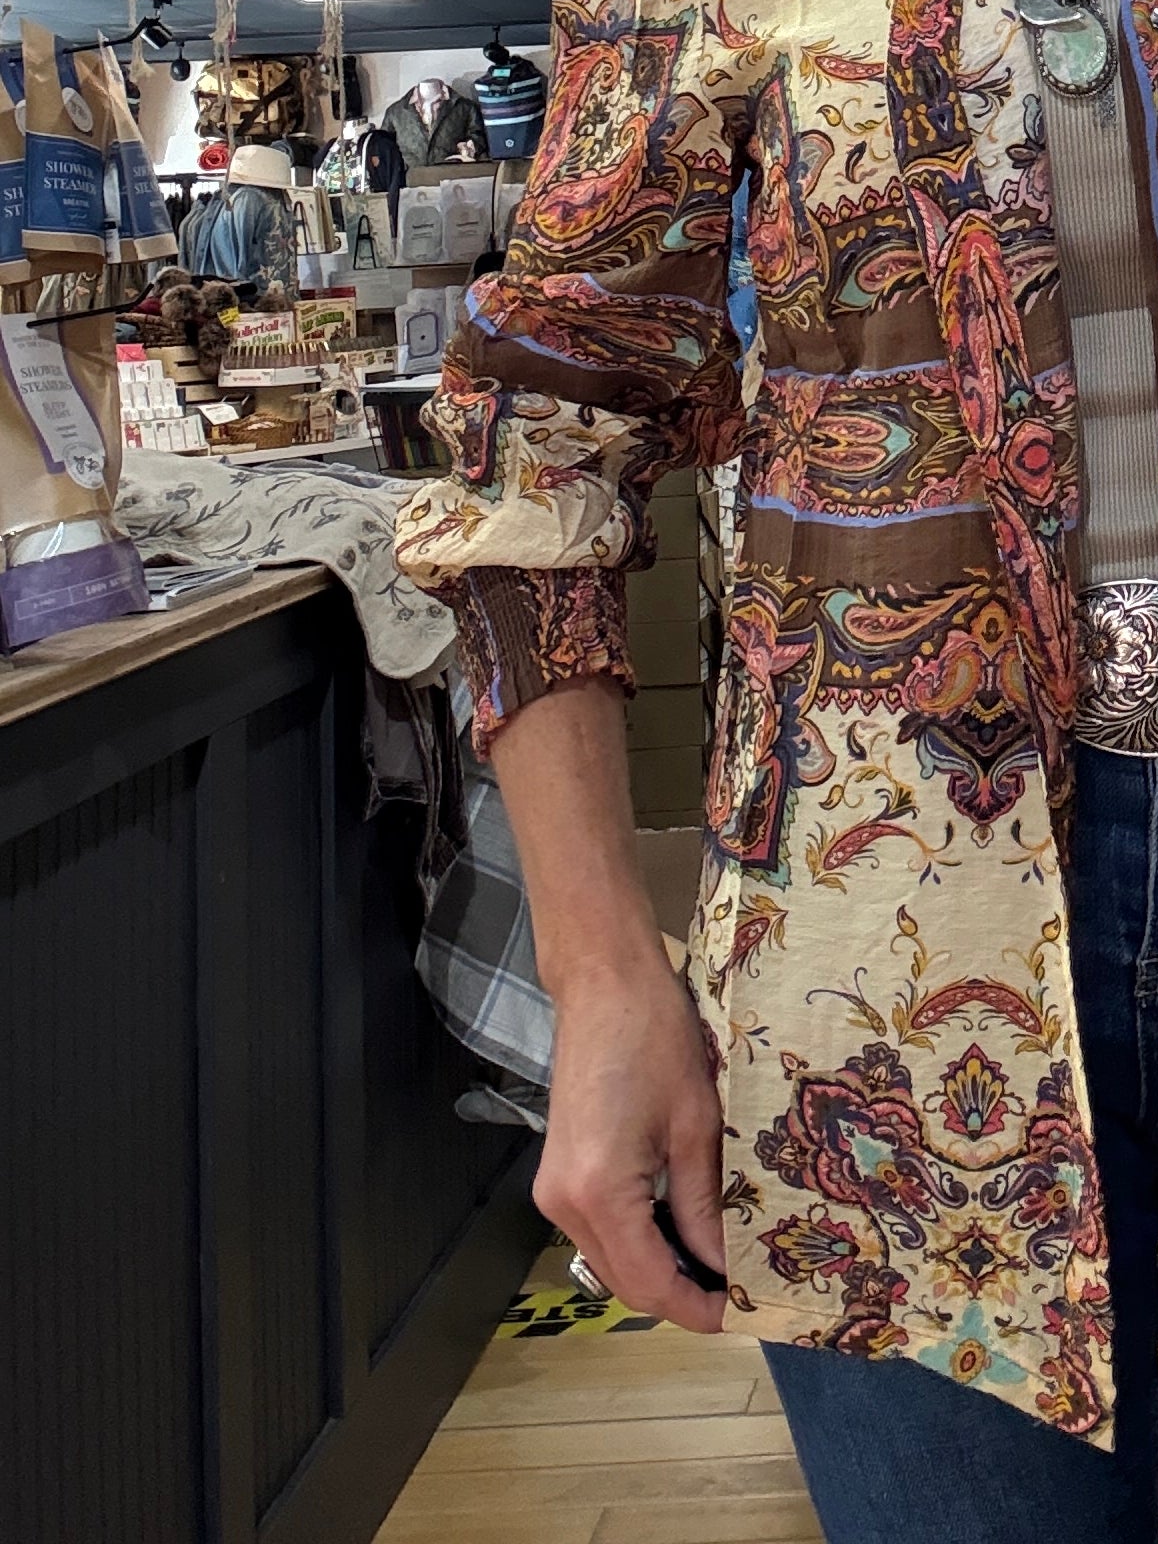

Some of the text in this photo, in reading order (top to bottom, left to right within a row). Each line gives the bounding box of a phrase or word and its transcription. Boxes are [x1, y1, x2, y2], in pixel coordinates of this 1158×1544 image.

[45, 160, 94, 179] SHOWER
[20, 365, 64, 378] SHOWER
[20, 380, 73, 394] STEAMERS
[502, 1302, 609, 1323] STE
